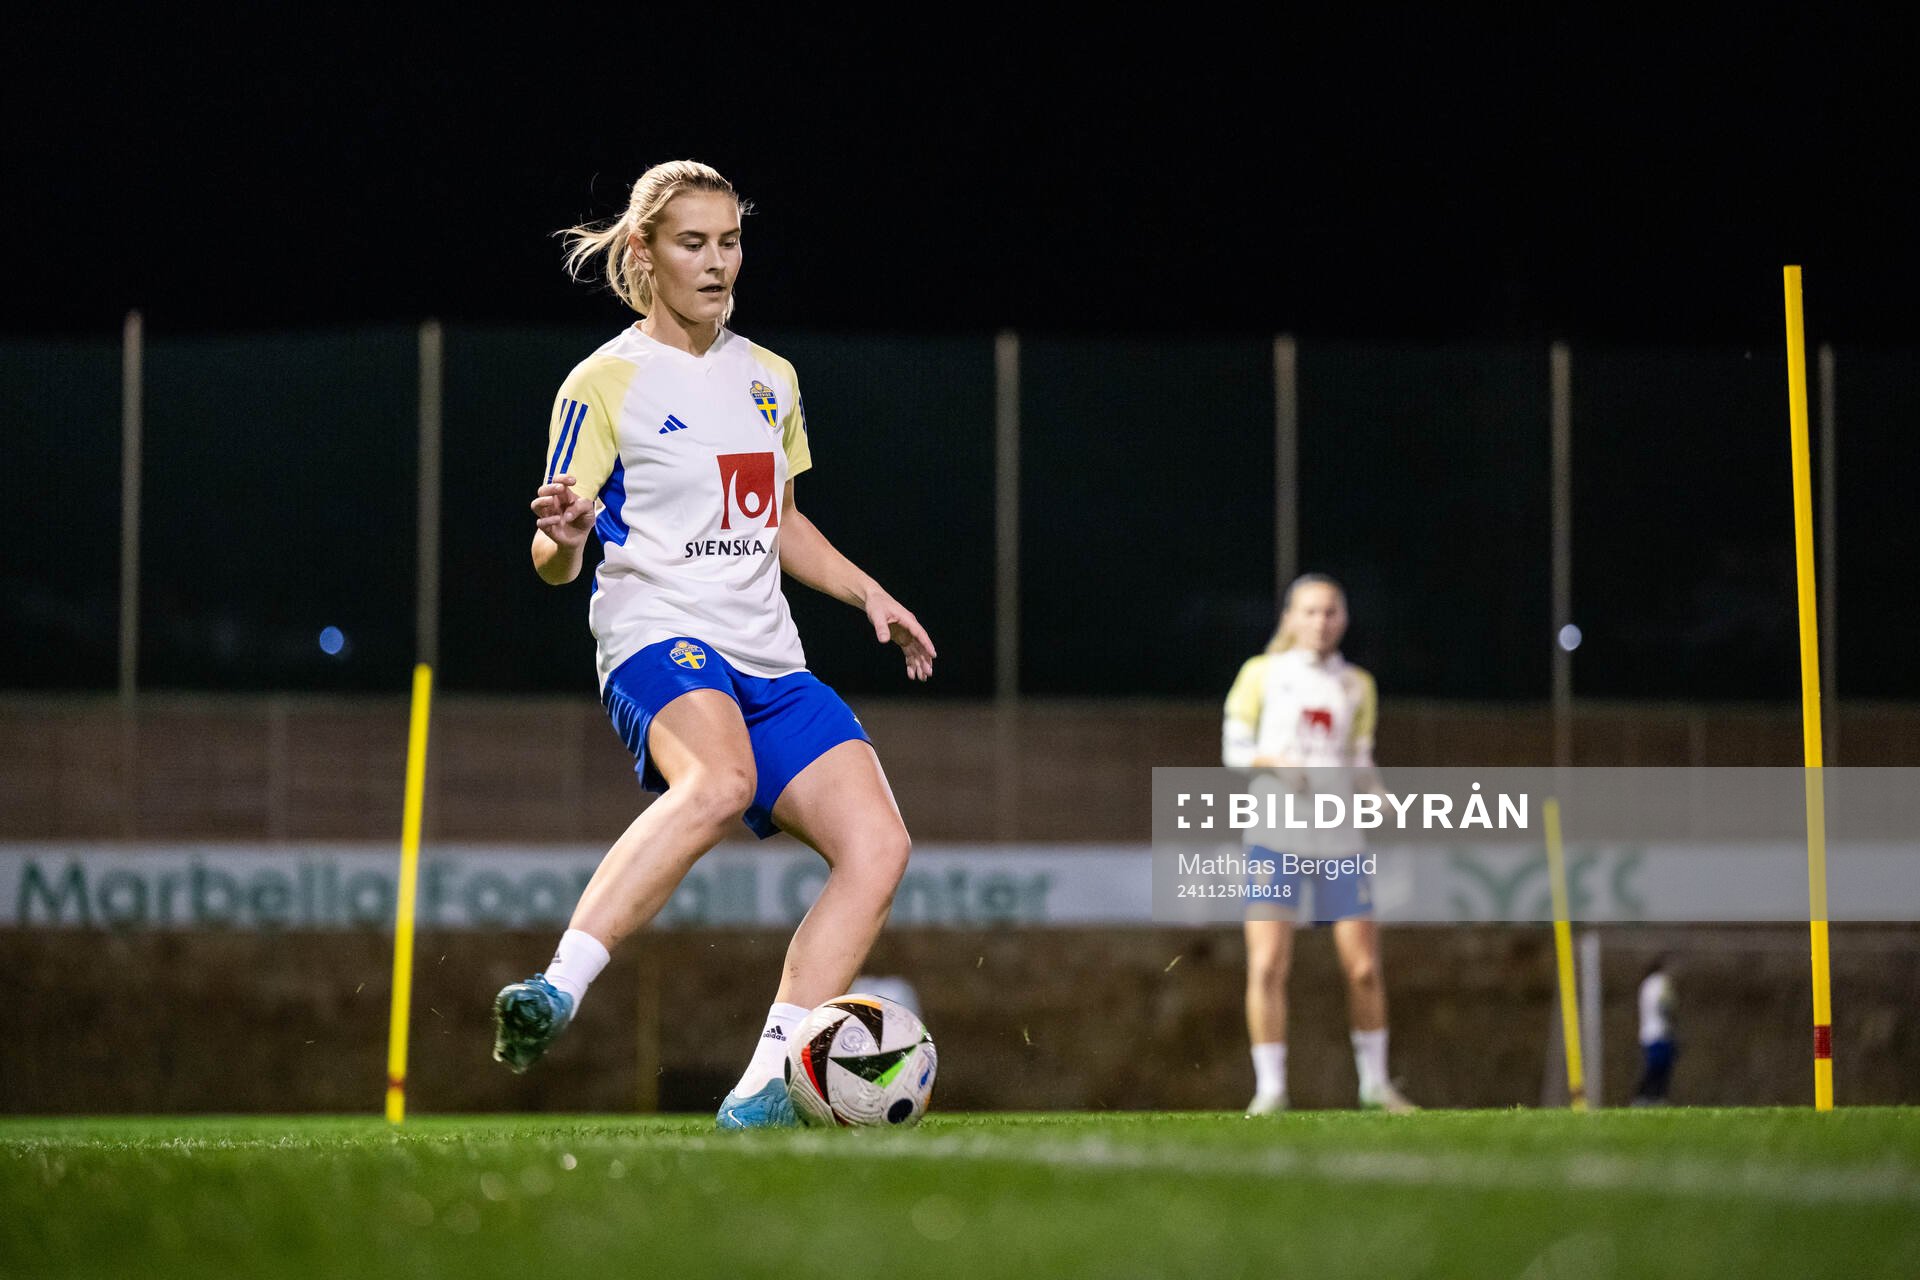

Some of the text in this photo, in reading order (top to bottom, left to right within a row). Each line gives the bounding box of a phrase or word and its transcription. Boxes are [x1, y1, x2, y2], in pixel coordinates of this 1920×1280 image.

[685, 539, 767, 558] SVENSKA
[14, 855, 399, 928] Marbella
[777, 859, 1055, 927] Cnter
